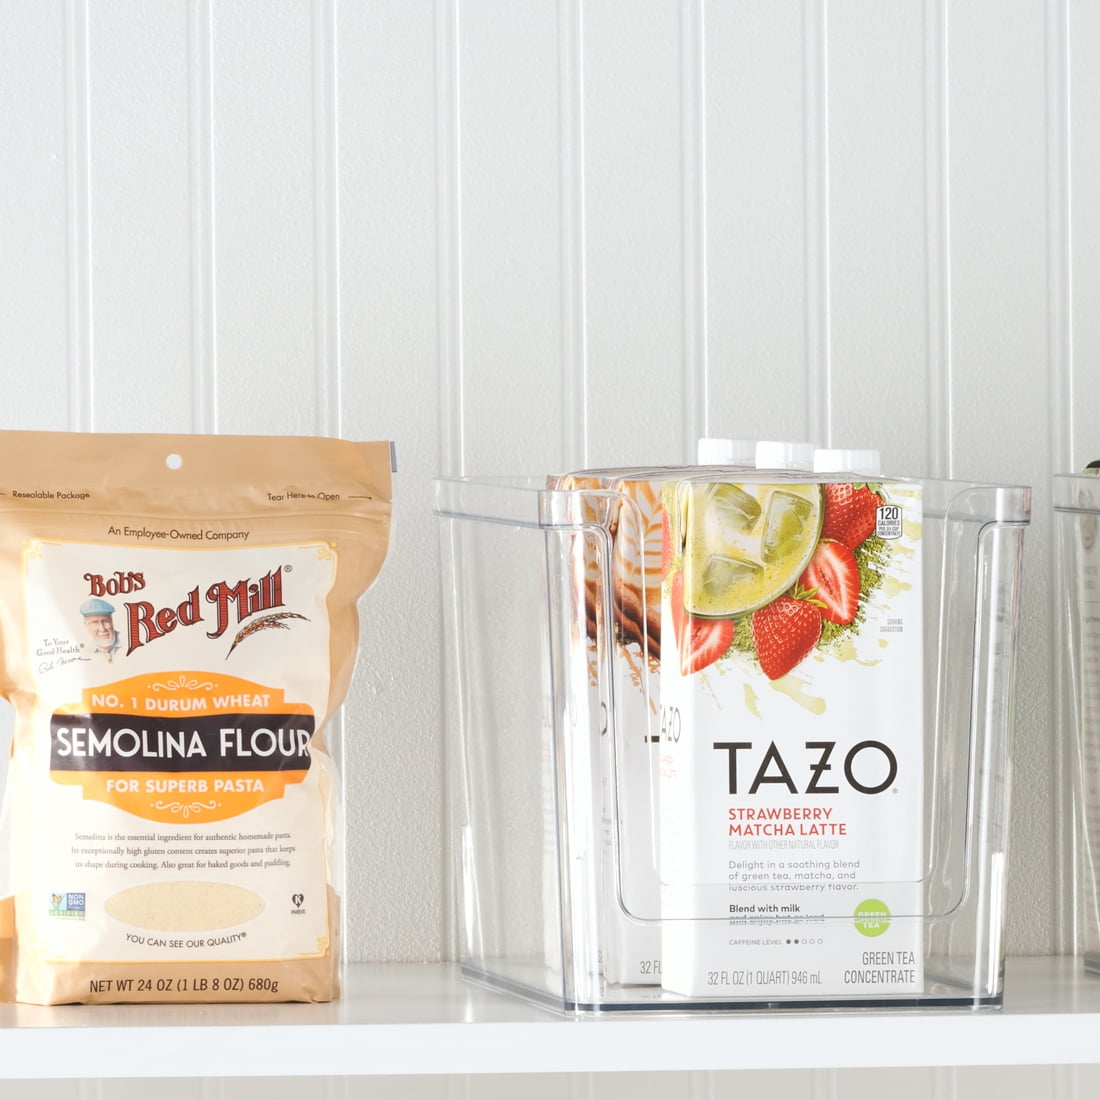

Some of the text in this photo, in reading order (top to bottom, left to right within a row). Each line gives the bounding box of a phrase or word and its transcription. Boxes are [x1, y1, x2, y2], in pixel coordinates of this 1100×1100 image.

[12, 490, 90, 501] Resealable Package
[267, 492, 284, 501] Tear
[317, 491, 340, 501] Open
[879, 507, 899, 520] 120
[107, 525, 250, 543] An Employee-Owned Company
[84, 571, 146, 597] Bob's
[123, 585, 205, 657] Red
[91, 694, 271, 712] NO. 1 DURUM WHEAT
[56, 727, 311, 759] SEMOLINA FLOUR
[712, 740, 898, 795] TAZO
[106, 778, 265, 793] FOR SUPERB PASTA
[728, 807, 833, 821] STRAWBERRY
[114, 832, 273, 843] the essential ingredient for authentic homemade
[728, 823, 847, 837] MATCHA LATTE
[728, 860, 764, 871] Delight
[767, 860, 776, 869] in
[787, 859, 831, 871] soothing
[833, 859, 860, 869] blend
[728, 871, 856, 882] of green tea, matcha, and
[770, 883, 825, 893] strawberry
[729, 903, 800, 913] Blend with milk
[126, 933, 145, 945] YOU
[147, 938, 167, 948] CAN
[169, 940, 184, 949] SEE
[186, 939, 205, 949] OUR
[862, 951, 915, 966] GREEN TEA
[707, 970, 823, 986] 32 FL OZ (1 QUART) 946 mL
[844, 969, 915, 984] CONCENTRATE
[89, 977, 279, 993] NET WT 24 OZ (1 LB 8 OZ) 680g
